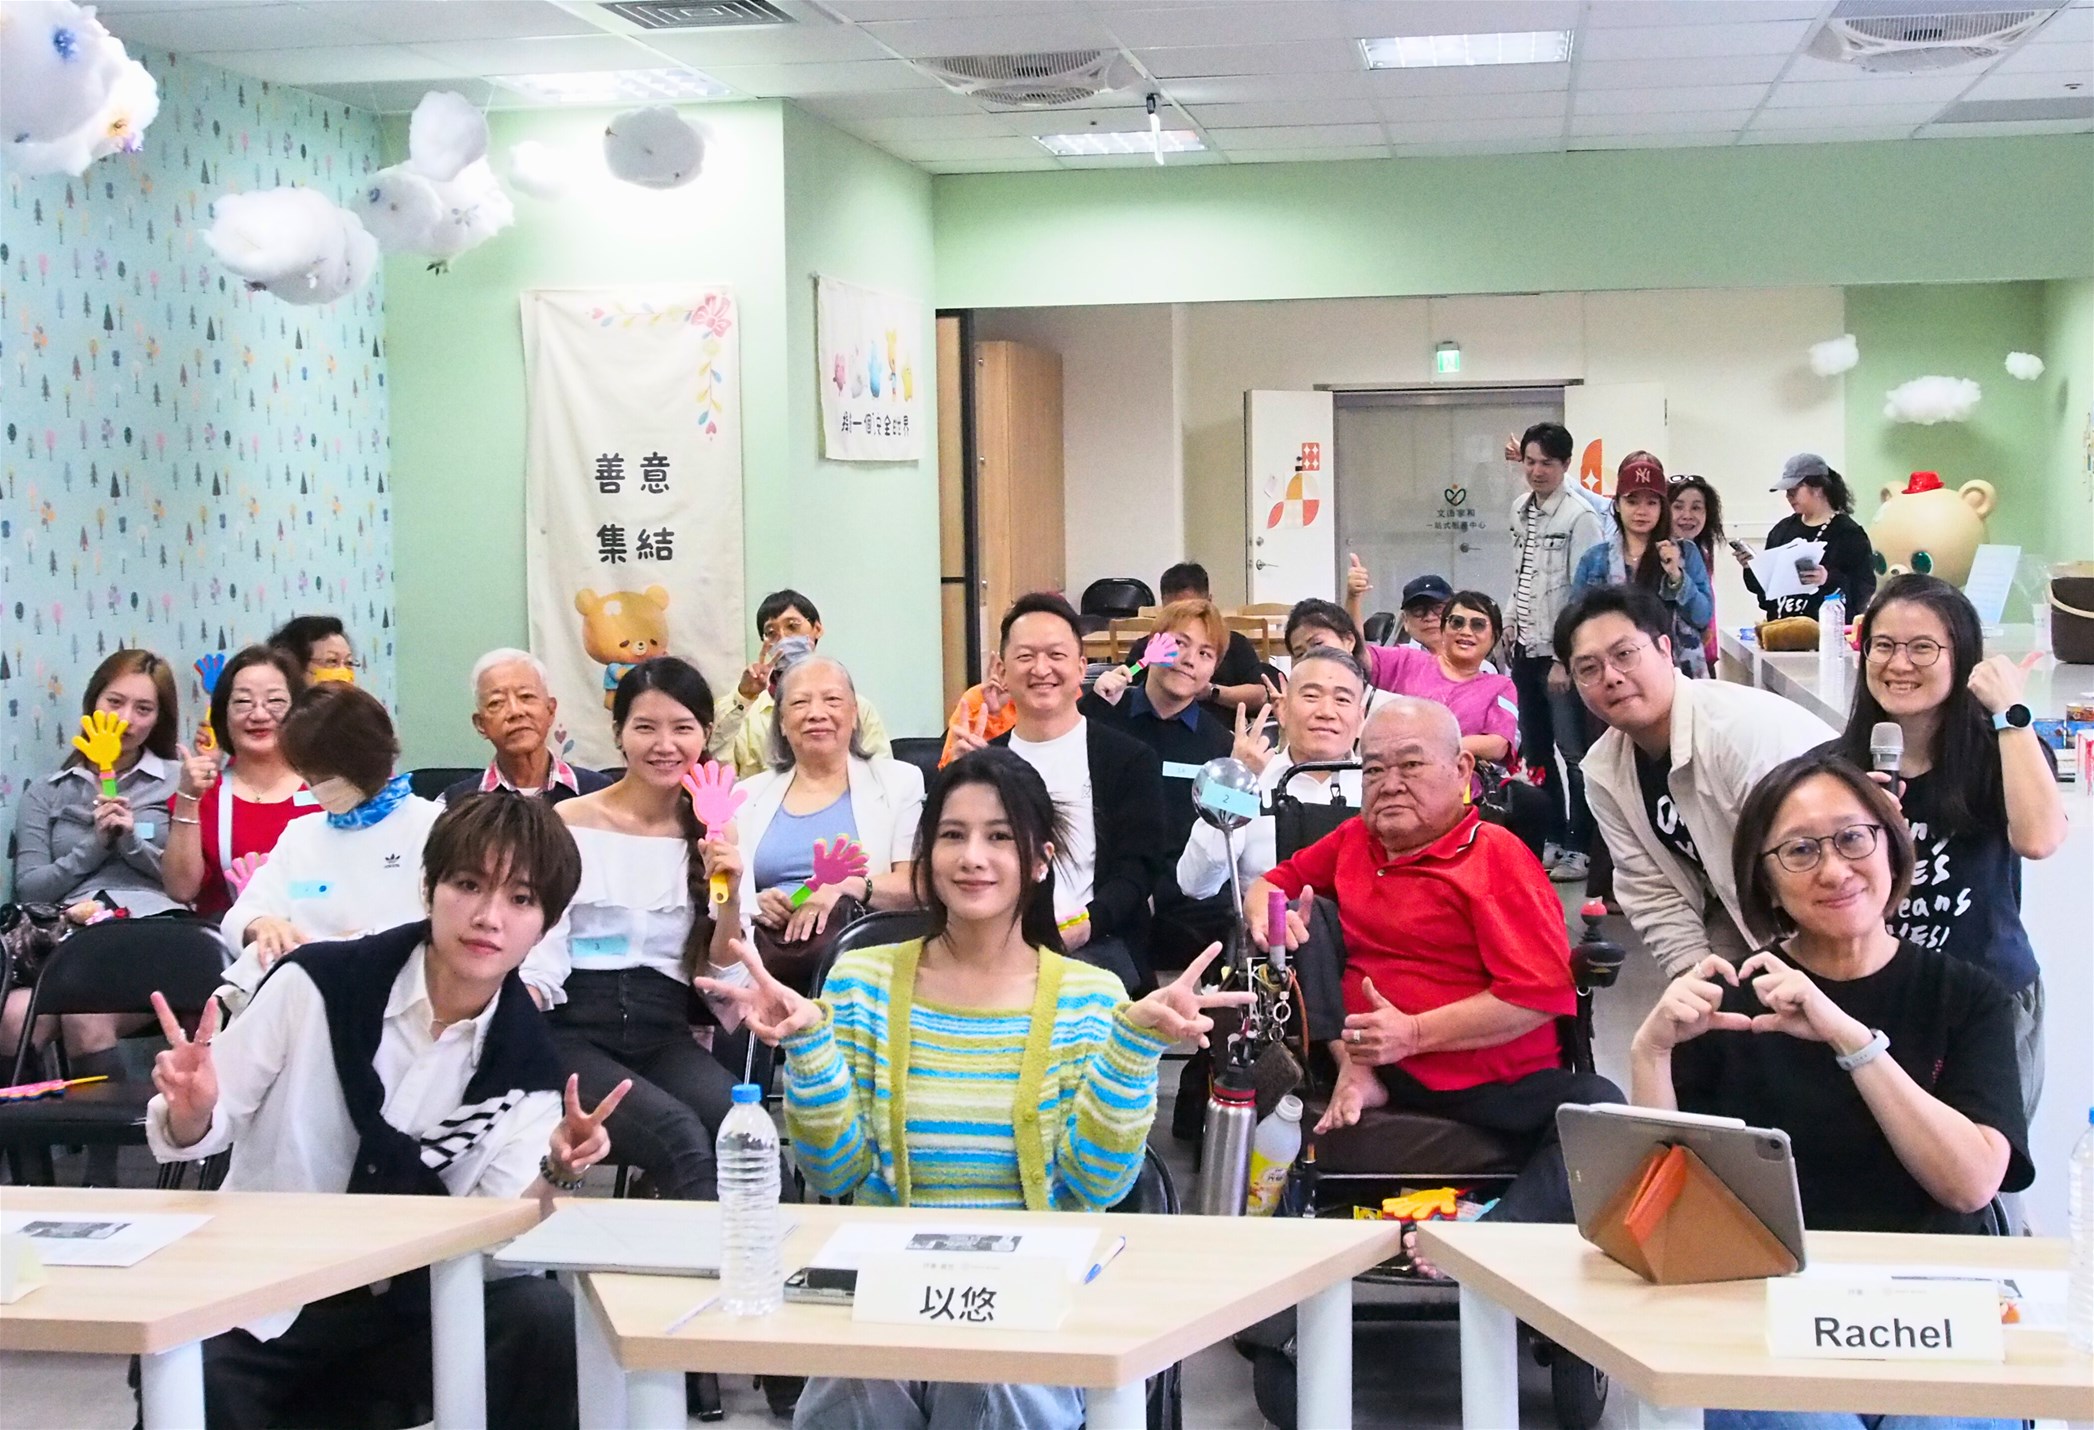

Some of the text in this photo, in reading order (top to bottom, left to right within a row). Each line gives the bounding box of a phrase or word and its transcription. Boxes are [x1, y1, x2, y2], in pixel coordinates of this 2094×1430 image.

[595, 451, 670, 494] 善意
[1635, 468, 1651, 483] NY
[596, 523, 675, 564] 集結
[1777, 596, 1808, 619] YES!
[1222, 794, 1230, 803] 2
[1910, 854, 1951, 886] ES
[1897, 888, 1972, 918] eans
[919, 1285, 997, 1322] 以悠
[1814, 1317, 1952, 1348] Rachel
